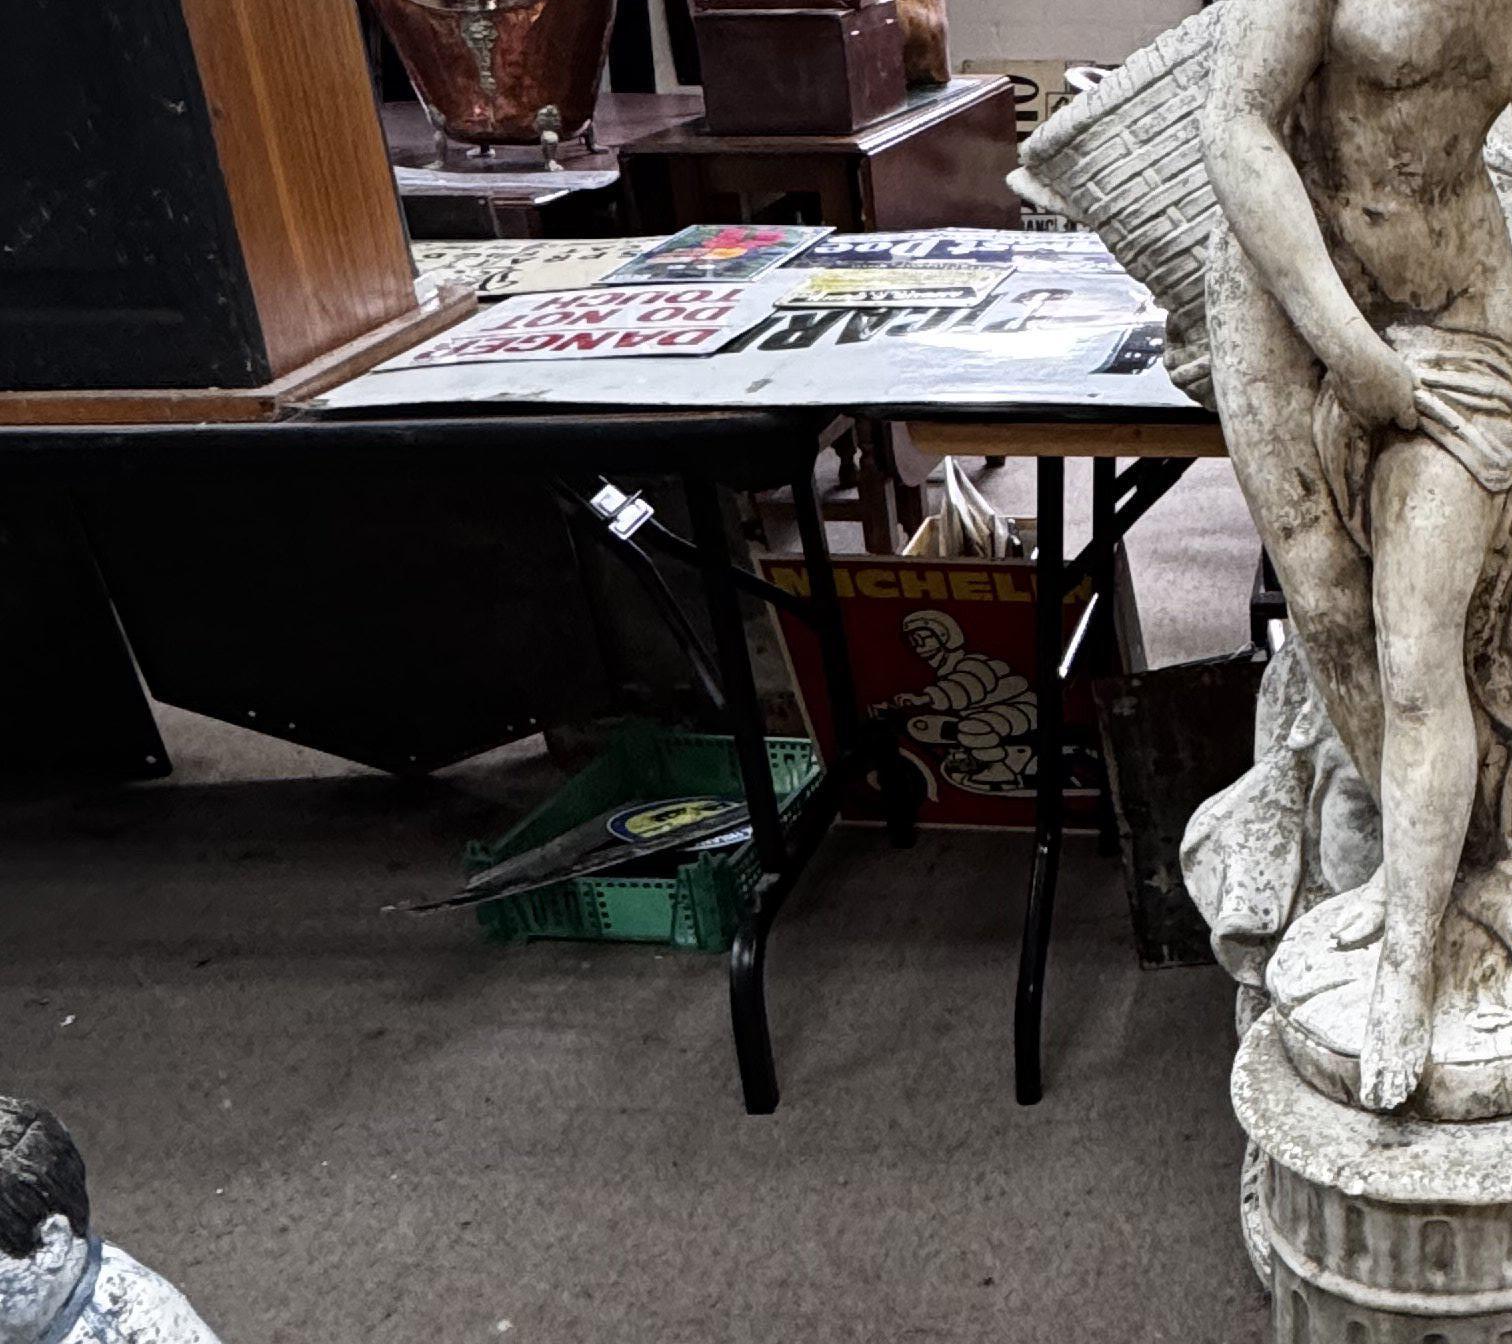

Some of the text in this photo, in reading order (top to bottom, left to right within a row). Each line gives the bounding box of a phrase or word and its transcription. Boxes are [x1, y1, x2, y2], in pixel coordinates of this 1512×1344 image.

[531, 287, 746, 312] TOUCH
[480, 305, 736, 332] DO NOT
[412, 327, 722, 363] DANGER
